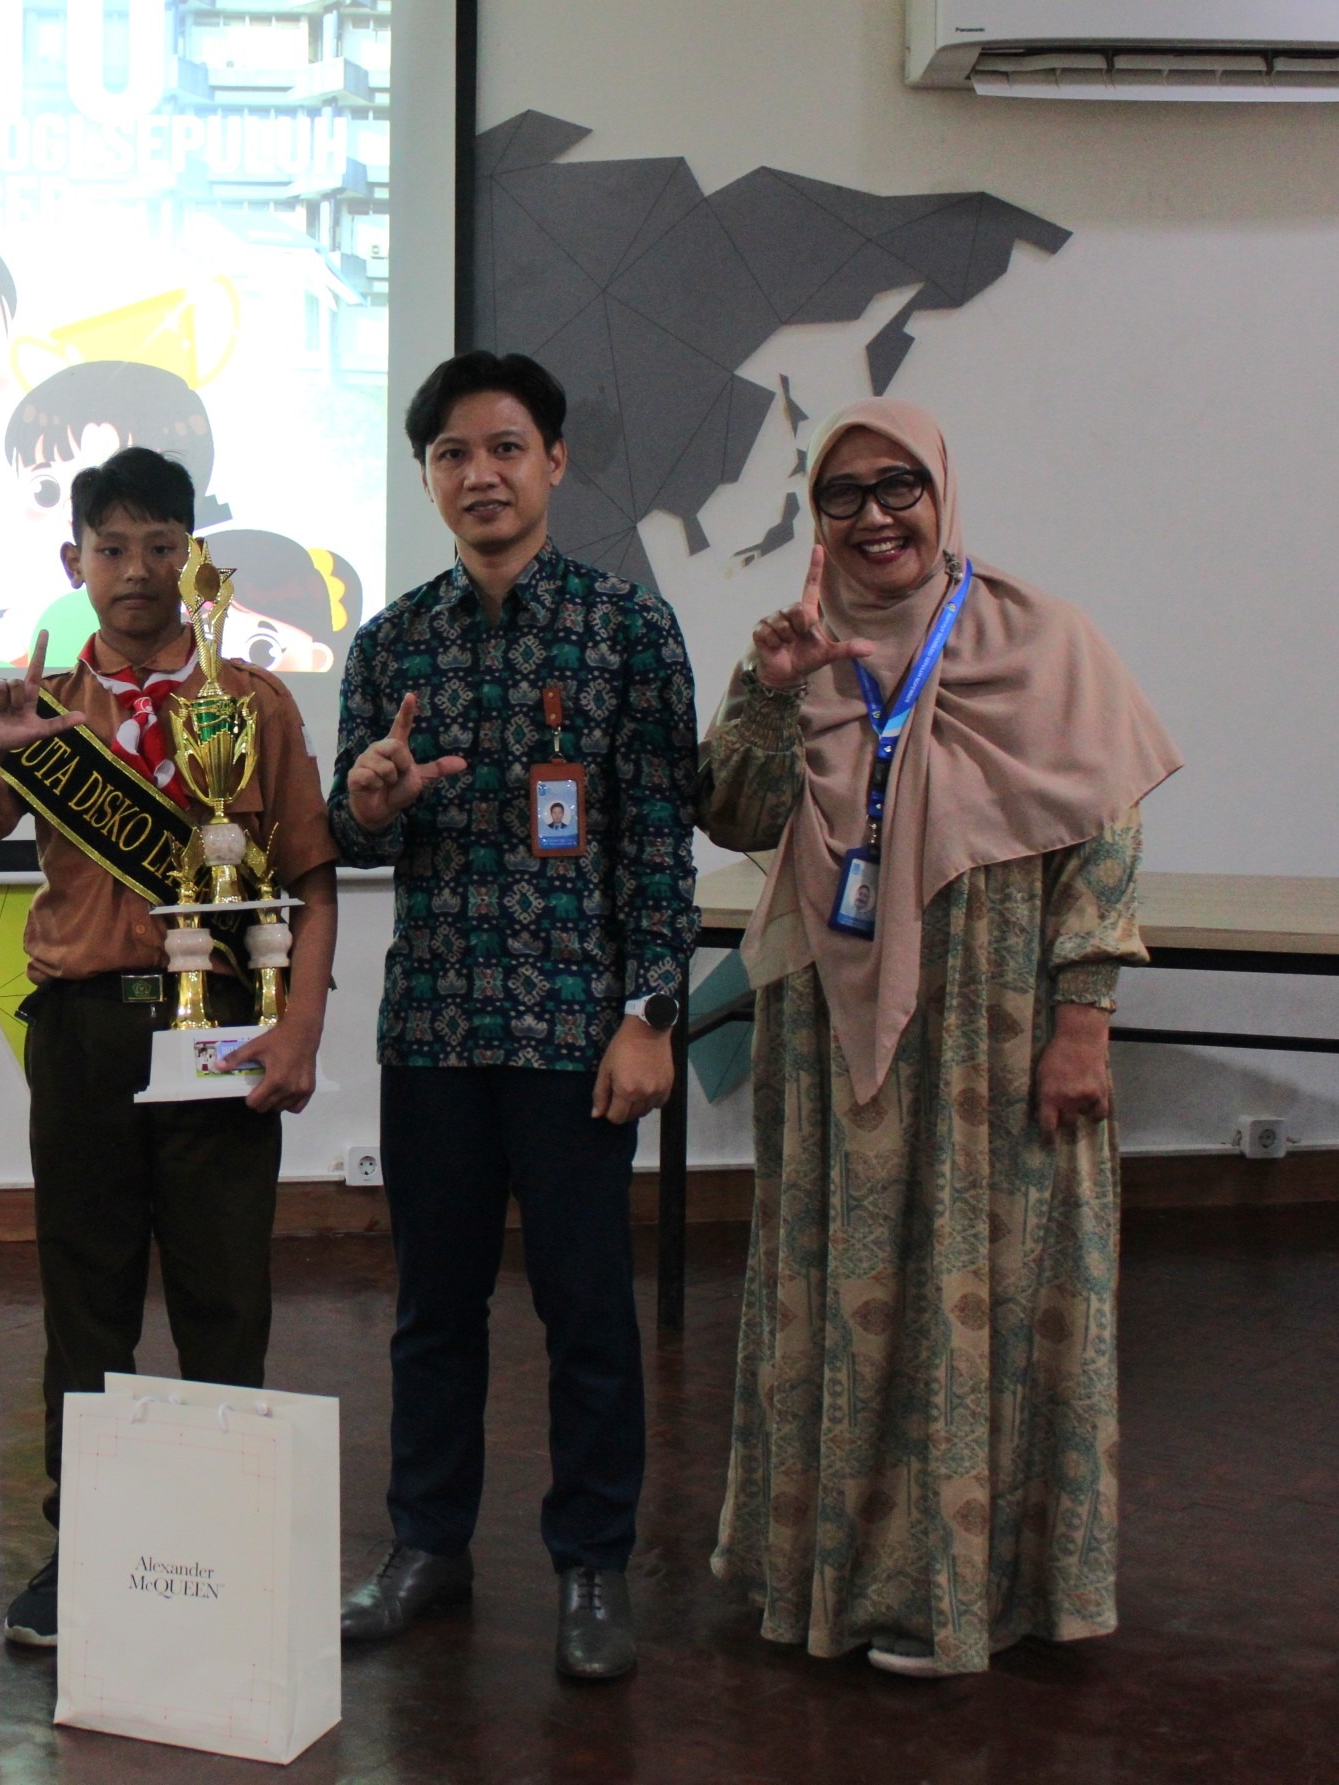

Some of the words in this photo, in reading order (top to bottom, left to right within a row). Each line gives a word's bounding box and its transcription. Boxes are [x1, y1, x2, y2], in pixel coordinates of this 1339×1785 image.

[102, 115, 348, 174] SEPULUH
[9, 737, 80, 796] UTA
[68, 770, 152, 851] DISKO
[129, 1573, 220, 1600] McQUEEN
[134, 1555, 215, 1579] Alexander
